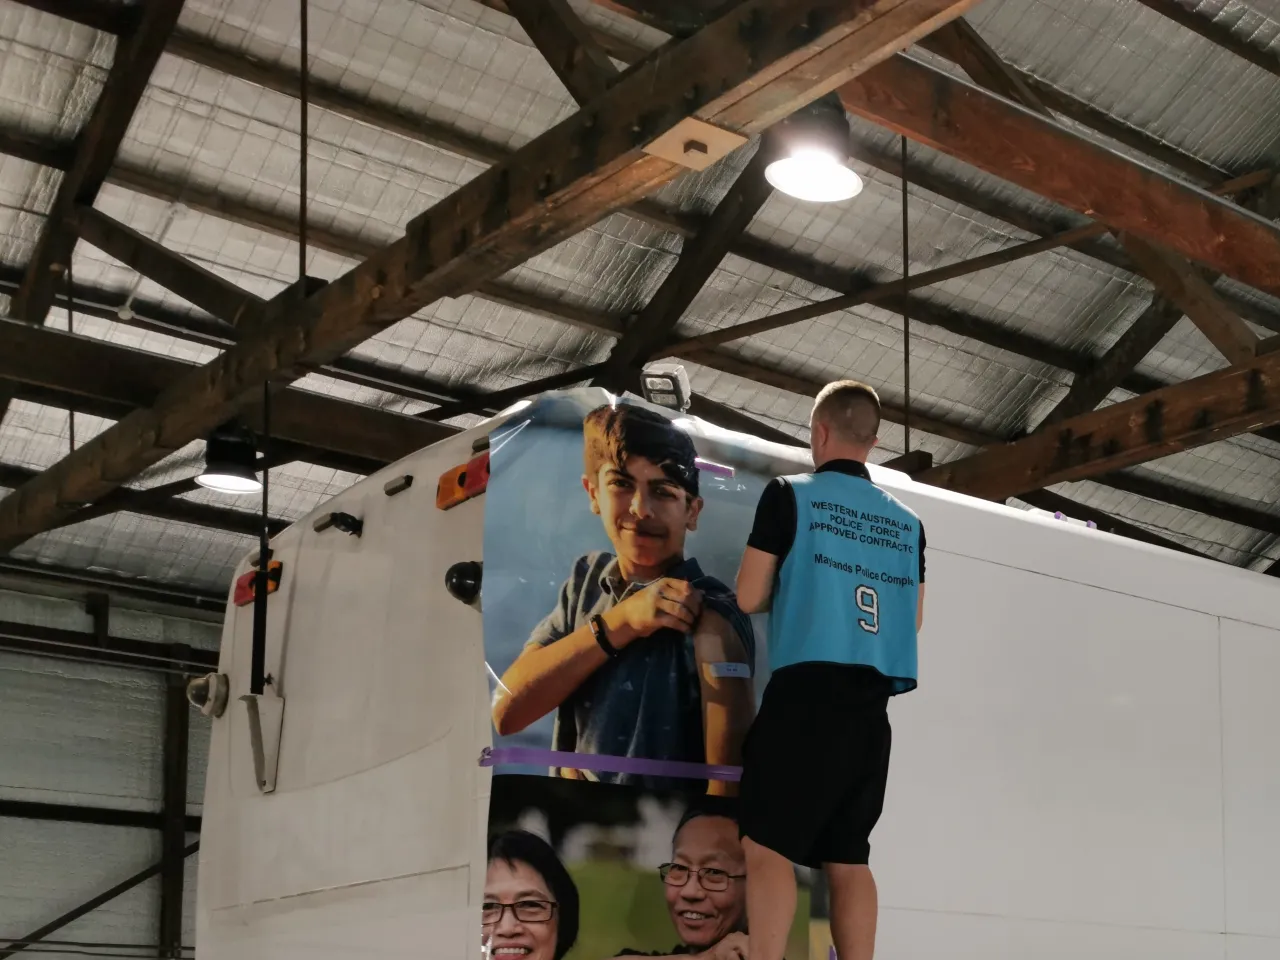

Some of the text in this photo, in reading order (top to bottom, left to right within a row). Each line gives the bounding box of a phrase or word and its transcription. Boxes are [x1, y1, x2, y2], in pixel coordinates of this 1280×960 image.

[811, 500, 858, 519] WESTERN
[809, 521, 858, 540] APPROVED
[829, 513, 900, 539] POLICE FORCE
[855, 564, 879, 581] Police
[855, 584, 879, 635] 9
